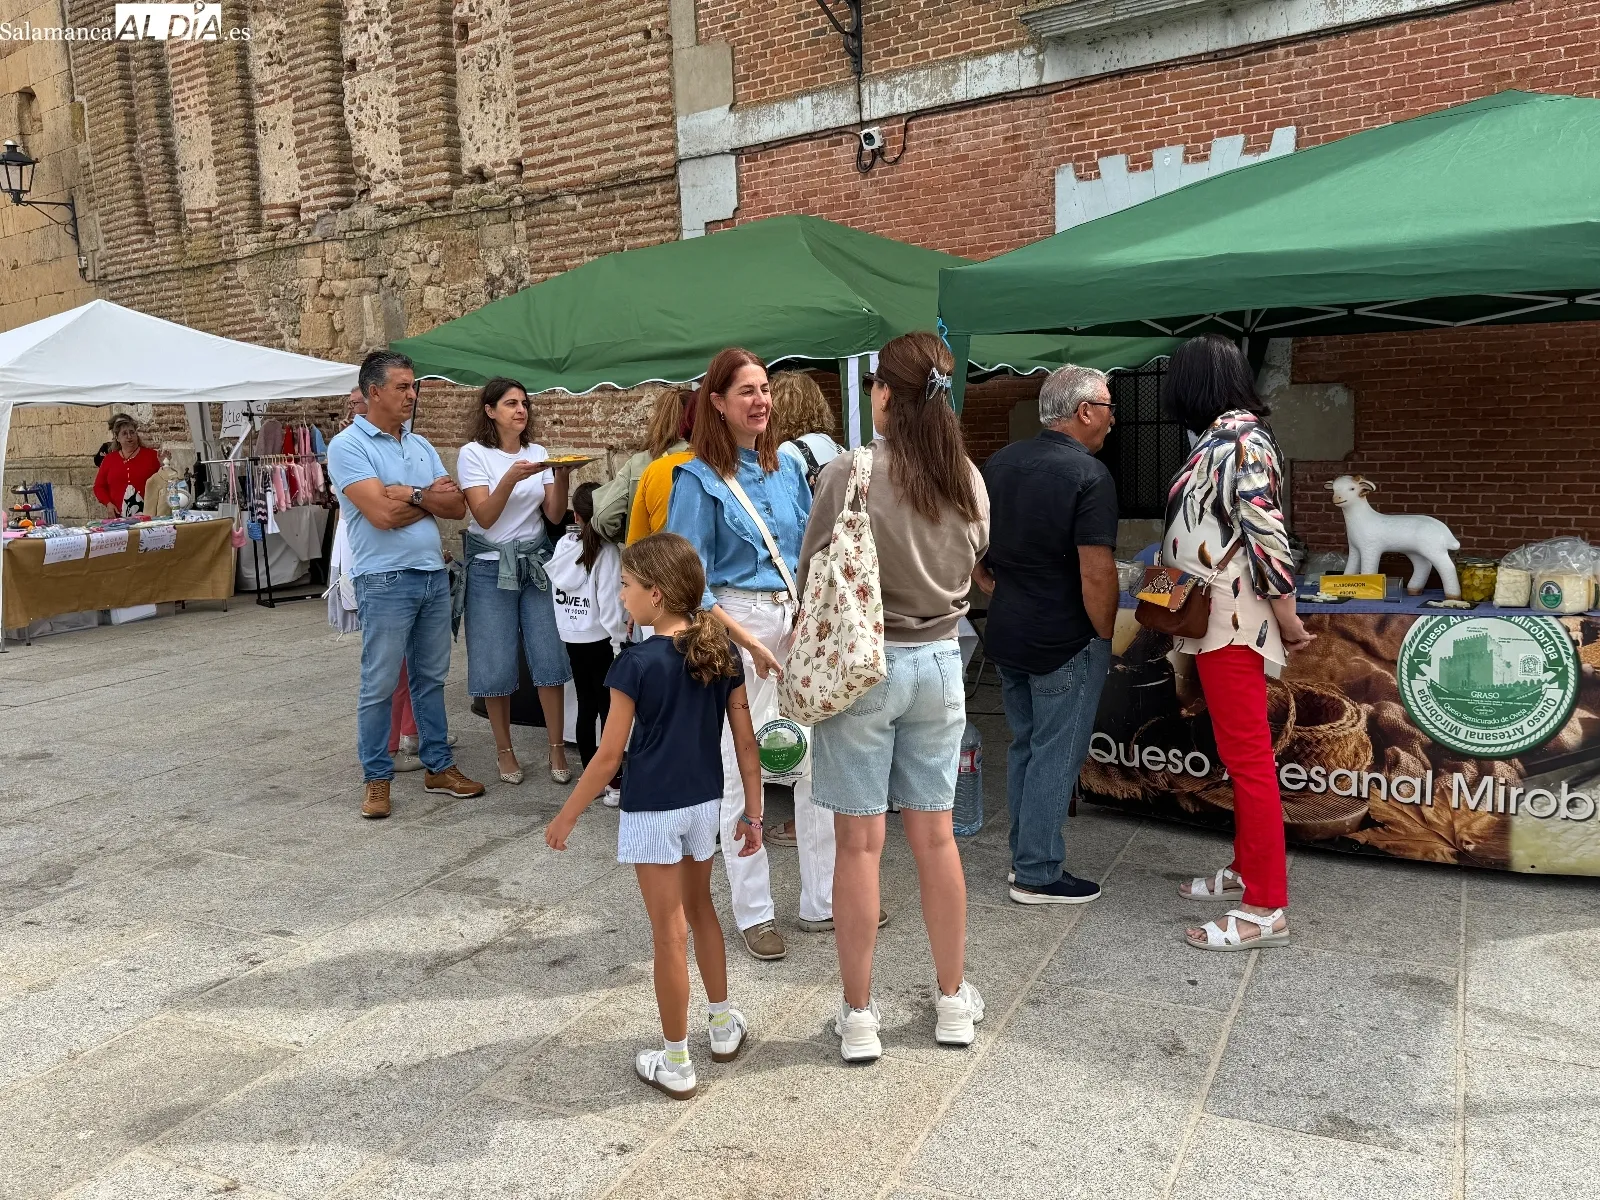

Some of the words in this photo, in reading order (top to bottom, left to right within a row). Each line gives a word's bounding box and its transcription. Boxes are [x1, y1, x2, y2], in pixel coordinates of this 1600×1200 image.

[91, 540, 127, 551] EFECTIVO
[1418, 623, 1448, 653] Queso
[1470, 690, 1500, 699] GRASO
[1416, 688, 1461, 737] Miróbriga
[1443, 702, 1462, 718] Queso
[1461, 712, 1500, 725] Semicurado
[1500, 714, 1509, 723] de
[1509, 707, 1527, 721] Oveja
[1526, 696, 1558, 728] Queso
[1464, 725, 1525, 742] Artesanal
[1088, 732, 1210, 777] Queso
[1451, 772, 1600, 821] Mirob
